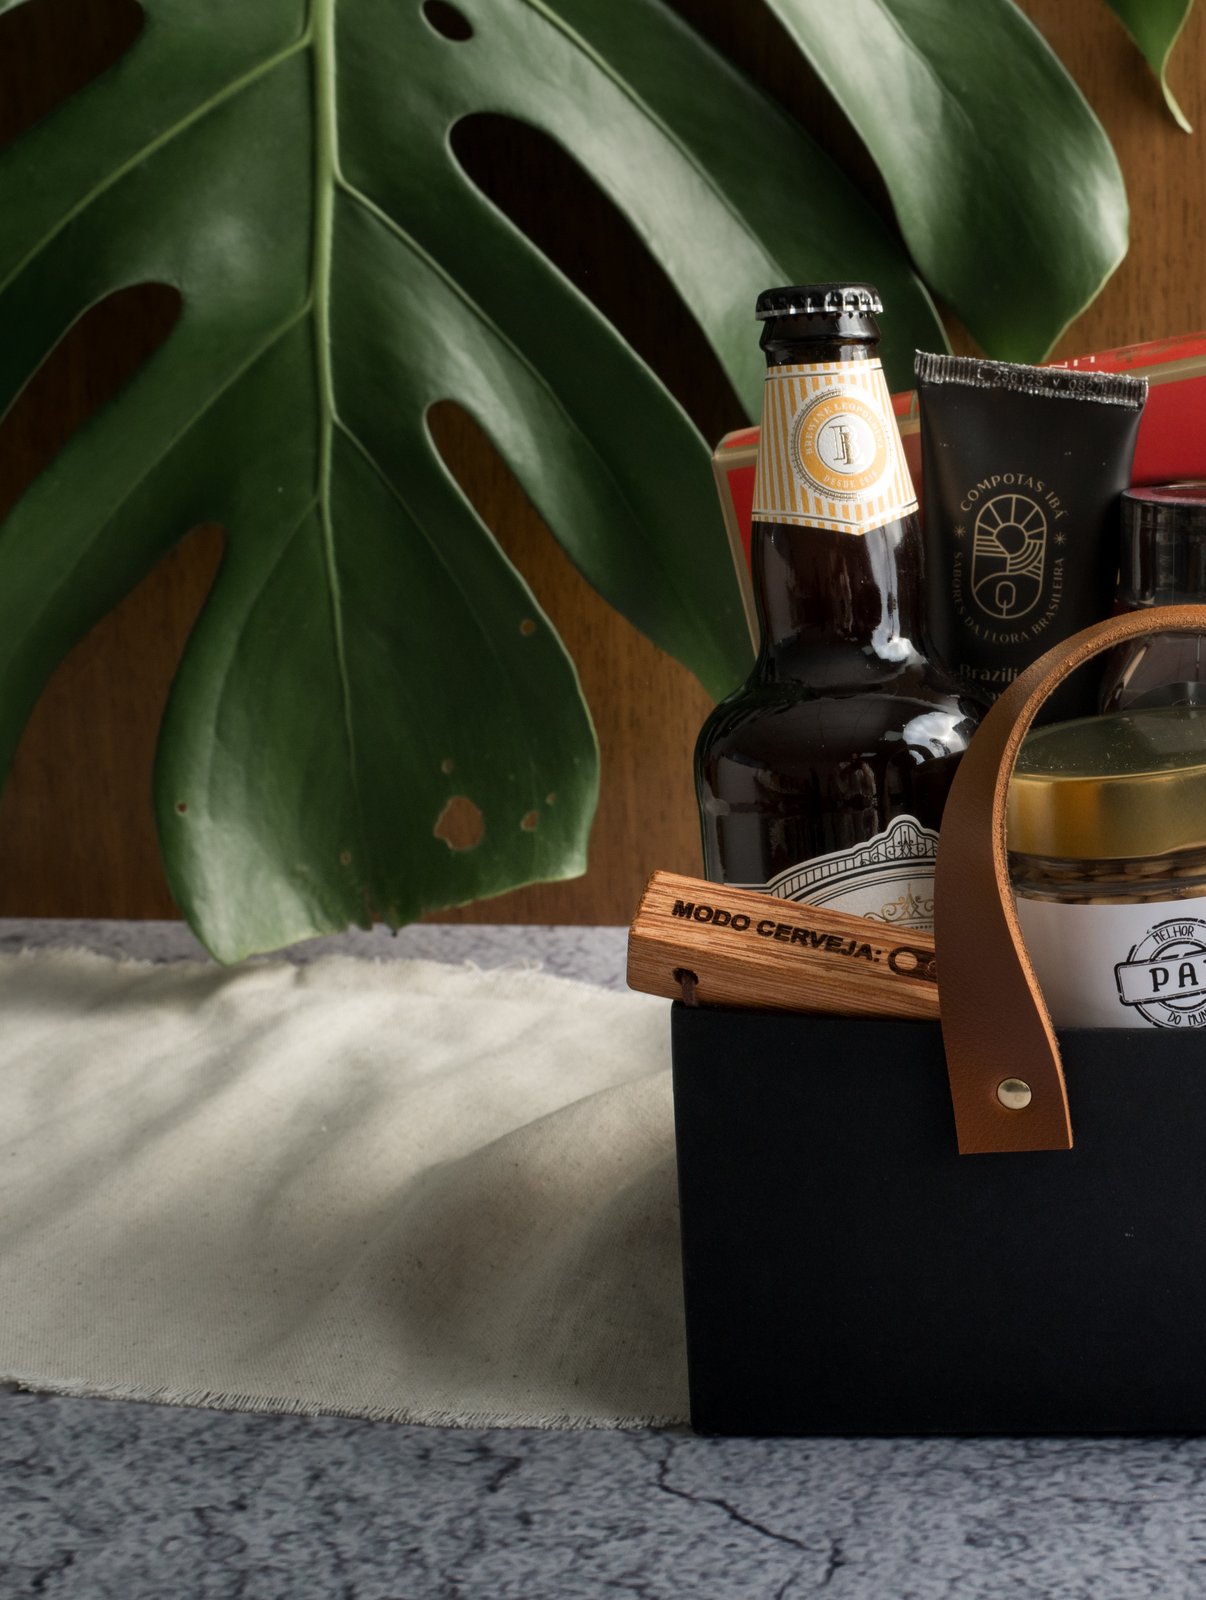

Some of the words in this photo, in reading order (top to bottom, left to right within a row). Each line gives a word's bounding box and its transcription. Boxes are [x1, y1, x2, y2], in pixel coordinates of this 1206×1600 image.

[960, 472, 1046, 512] COMPOTAS
[963, 615, 981, 637] DA
[983, 630, 1031, 644] FLORA
[1031, 557, 1065, 635] BRASILEIRA
[959, 663, 1019, 683] Brazili
[671, 899, 751, 931] MODO
[756, 919, 882, 963] CERVEJA:
[1152, 925, 1195, 944] MELHOR
[1167, 1011, 1182, 1026] DO
